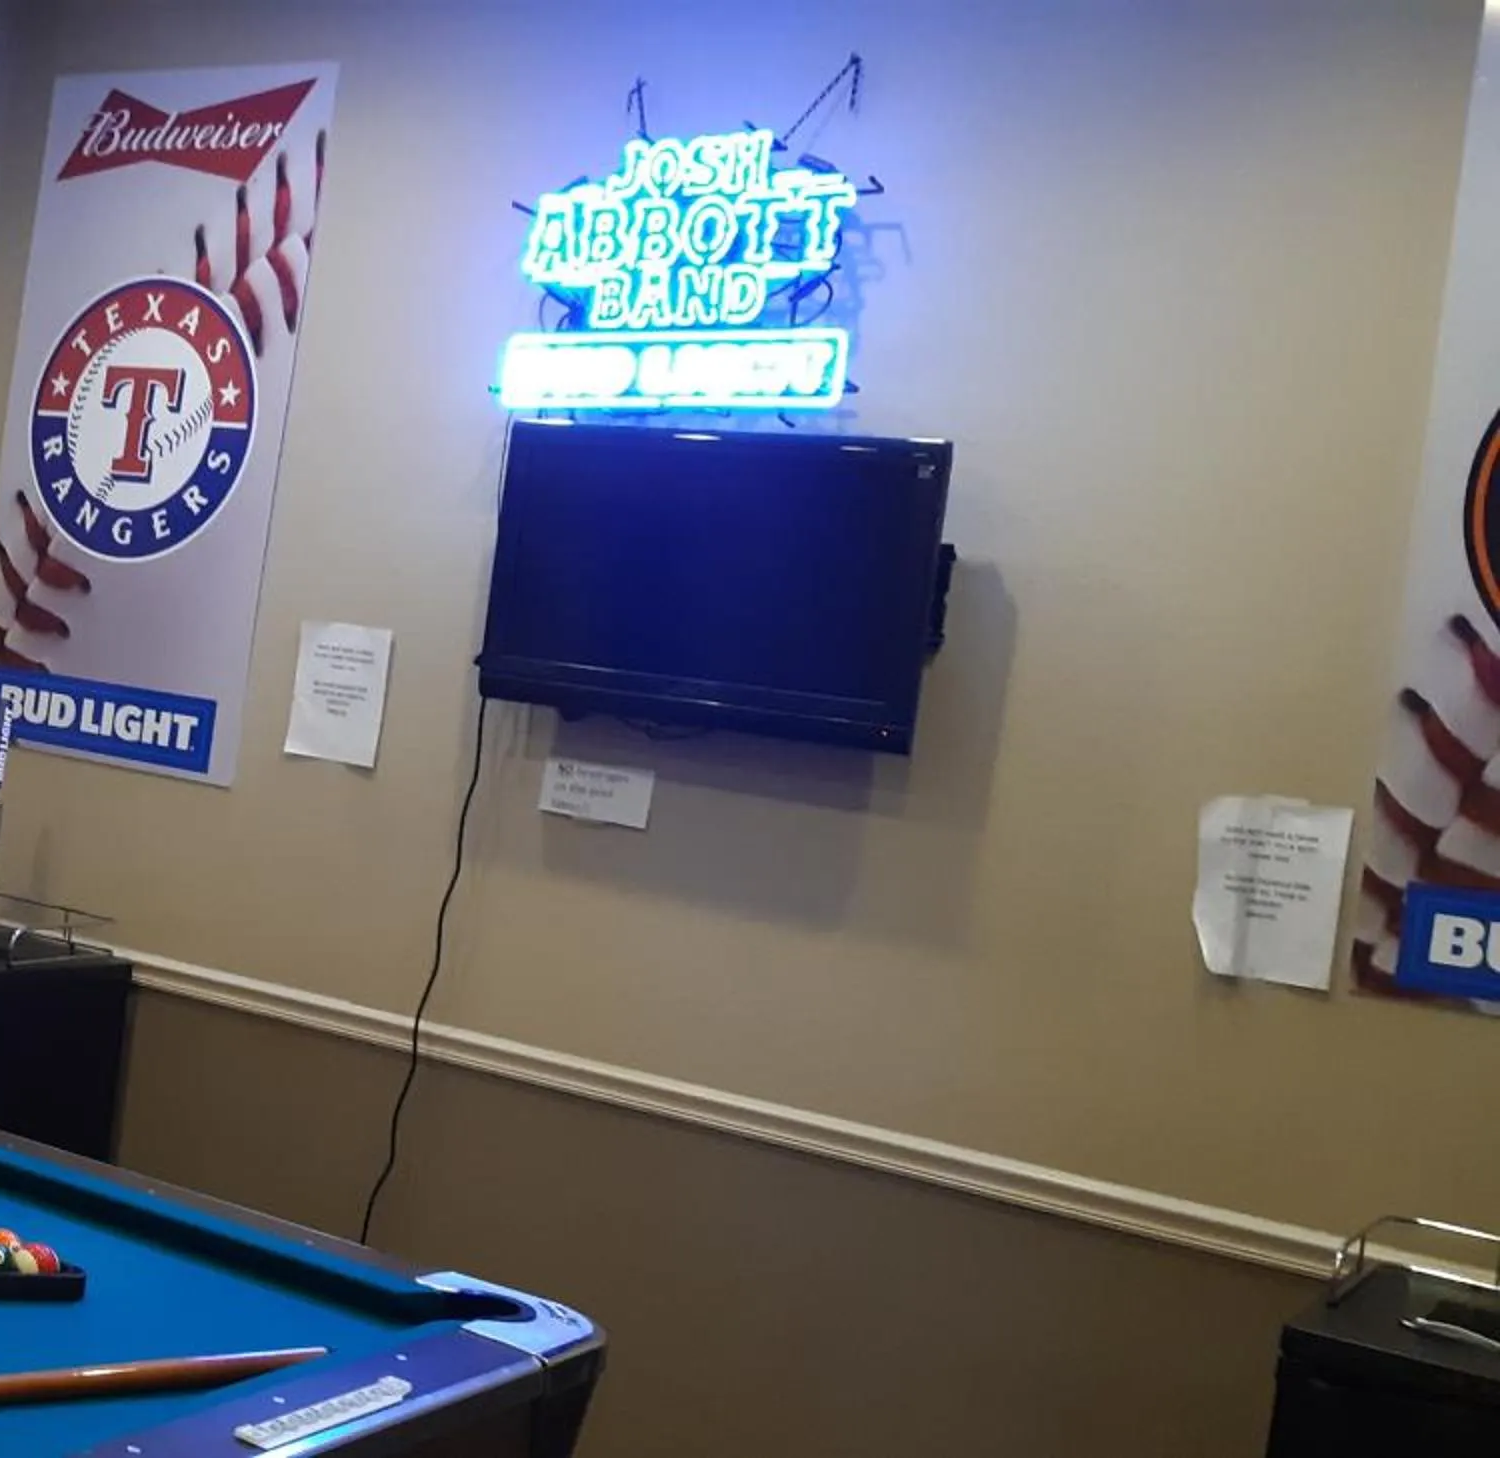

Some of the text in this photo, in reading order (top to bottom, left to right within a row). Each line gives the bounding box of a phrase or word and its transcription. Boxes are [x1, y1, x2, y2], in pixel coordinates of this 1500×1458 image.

[81, 108, 284, 158] Budweiser
[607, 129, 774, 197] JOSH
[521, 171, 857, 280] ABBOTT
[71, 293, 231, 364] TEXAS
[591, 264, 766, 330] BAND
[101, 365, 187, 483] T
[43, 435, 231, 545] RANGERS
[1, 684, 199, 751] BUD LIGHT
